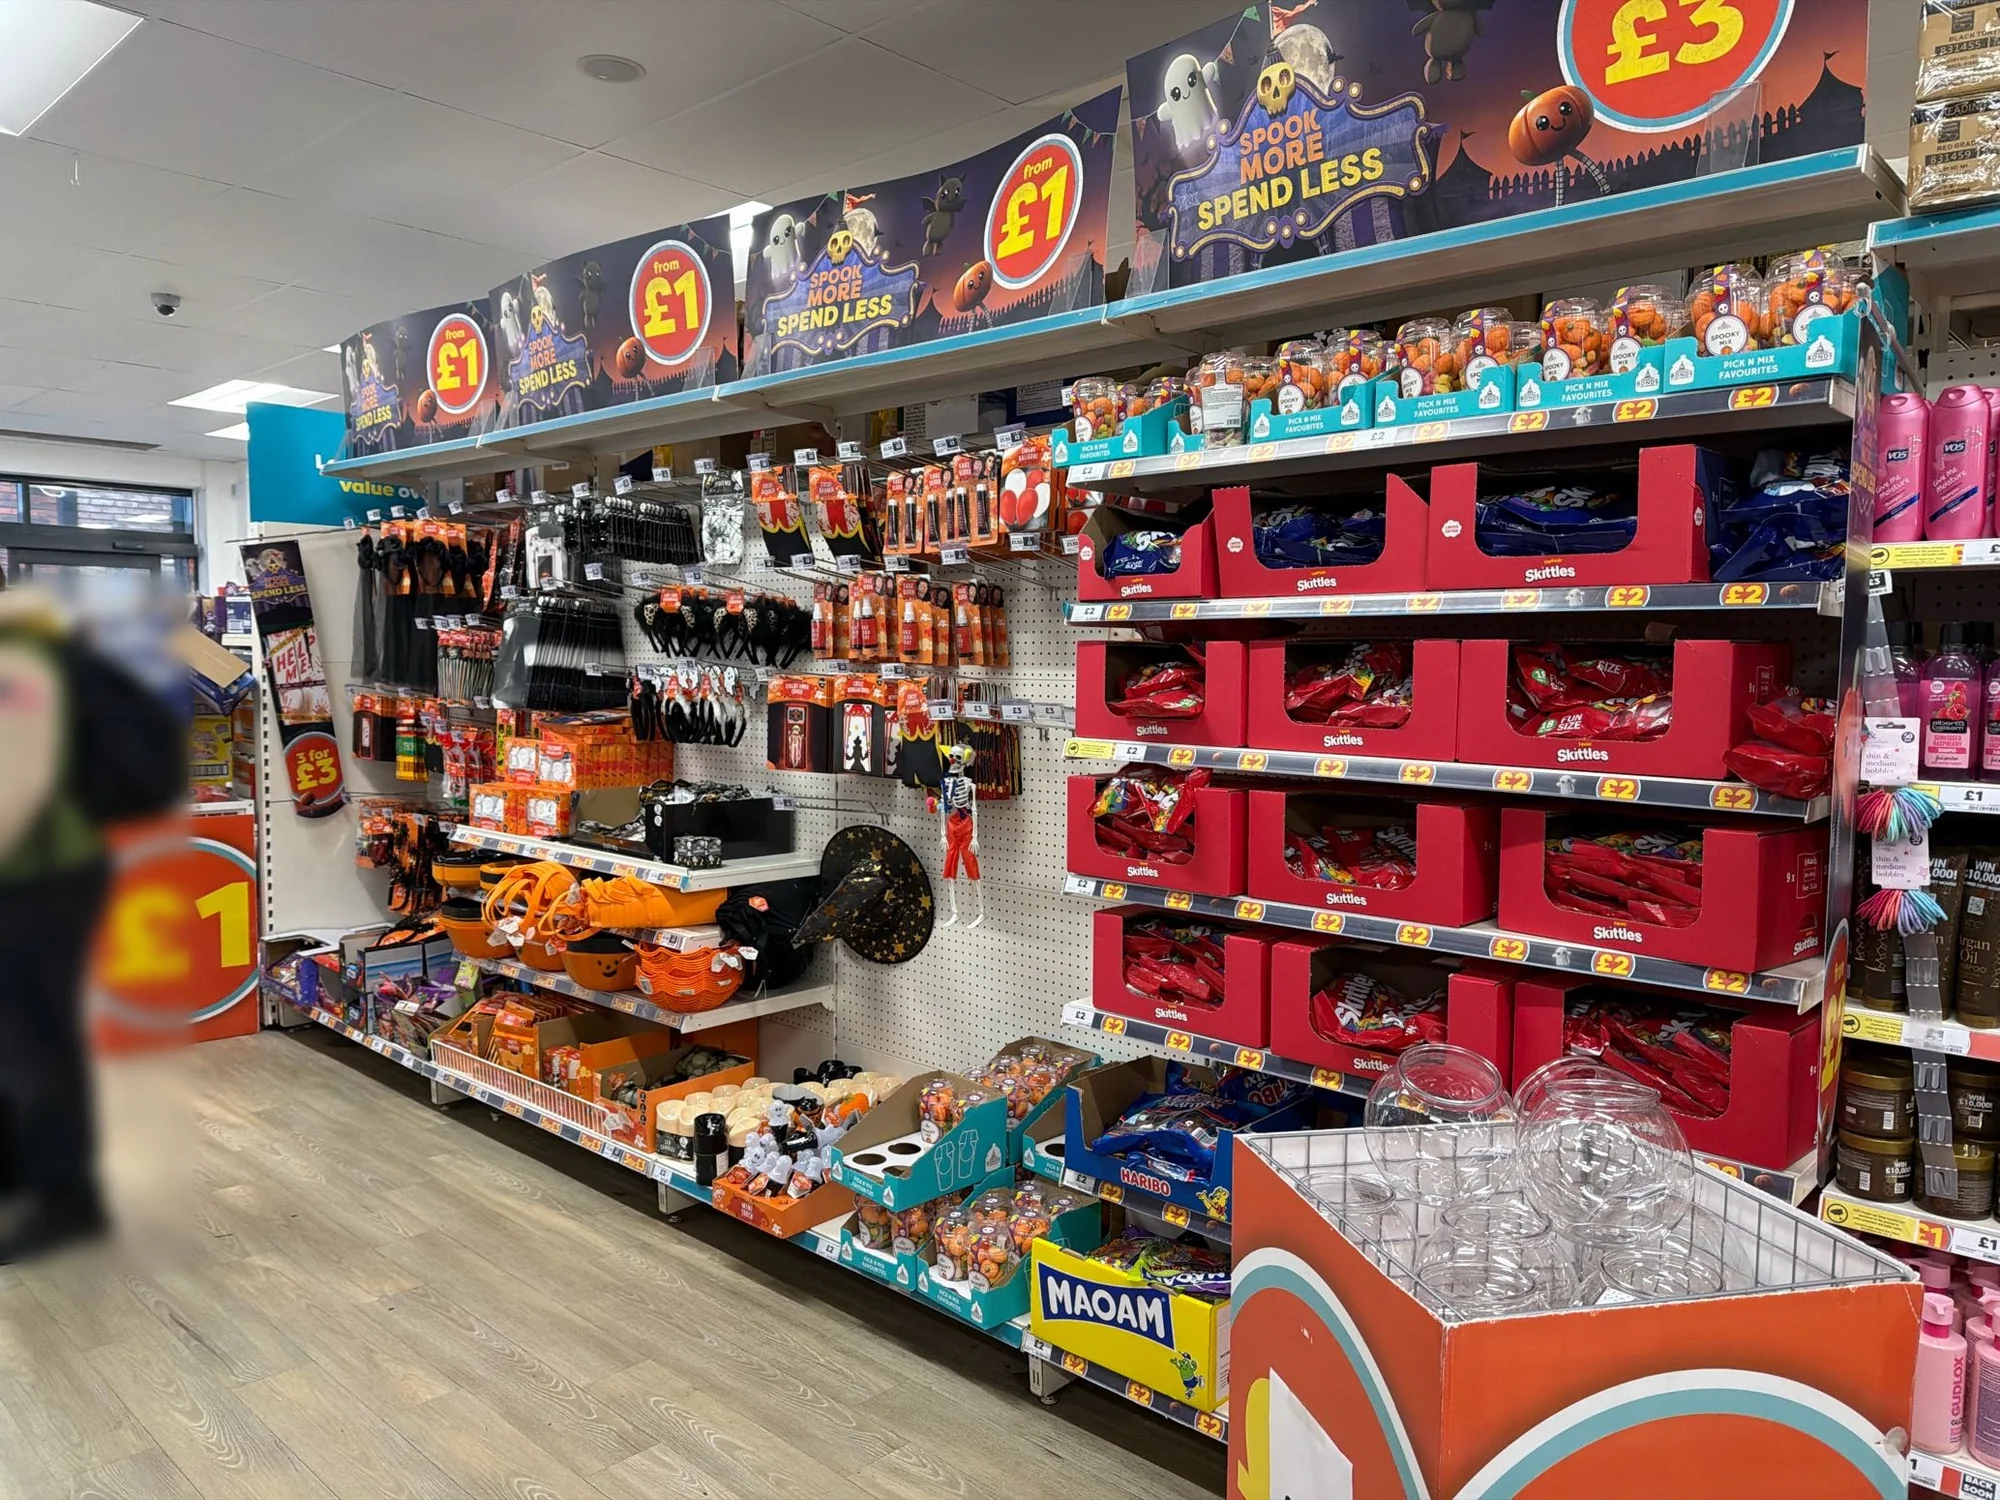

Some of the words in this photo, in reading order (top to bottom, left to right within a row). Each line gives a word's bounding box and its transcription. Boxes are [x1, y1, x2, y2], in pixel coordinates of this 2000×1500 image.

[1604, 0, 1746, 85] £3
[1940, 40, 1982, 56] 831455
[1240, 108, 1322, 156] SPOOK
[1937, 144, 1953, 152] RED
[1240, 134, 1325, 185] MORE
[1930, 150, 1972, 164] 831459
[1023, 155, 1053, 181] from
[1197, 176, 1293, 231] SPEND
[1301, 147, 1385, 199] LESS
[996, 164, 1069, 260] £1
[653, 259, 680, 274] from
[810, 264, 862, 289] SPOOK
[807, 279, 861, 307] MORE
[643, 268, 701, 337] £1
[777, 301, 840, 337] SPEND
[842, 294, 892, 324] LESS
[445, 329, 465, 339] from
[1710, 331, 1740, 342] SPOOKY
[1719, 338, 1732, 346] MIX
[528, 336, 554, 356] SPOOK
[529, 349, 557, 371] MORE
[1613, 352, 1636, 360] SPOOKY
[1723, 359, 1744, 369] PICK
[1748, 358, 1754, 366] N
[1756, 355, 1775, 365] MIX
[1807, 353, 1833, 361] BONDS
[436, 338, 478, 391] £1
[1719, 365, 1779, 379] FAVOURITES
[519, 368, 549, 395] SPEND
[551, 359, 577, 385] LESS
[1565, 383, 1584, 393] PICK
[1586, 382, 1592, 390] N
[1593, 380, 1609, 389] MIX
[1417, 400, 1435, 409] PICK
[1436, 399, 1442, 407] N
[1442, 397, 1456, 406] MIX
[1561, 389, 1612, 402] FAVOURITES
[1735, 387, 1772, 408] £2
[356, 411, 373, 431] SPEND
[374, 405, 391, 425] LESS
[1414, 406, 1459, 418] FAVOURITES
[1619, 400, 1652, 421] £2
[1516, 414, 1542, 429] £2
[1370, 432, 1385, 441] £2
[1111, 463, 1132, 476] £2
[339, 480, 394, 497] value
[1524, 566, 1576, 582] Skittles
[1120, 584, 1152, 598] Skittles
[1297, 576, 1336, 591] Skittles
[251, 587, 283, 600] SPEND
[284, 584, 306, 593] LESS
[1611, 588, 1645, 606] £2
[1725, 585, 1762, 604] £2
[1084, 607, 1095, 616] £2
[1107, 606, 1129, 619] £2
[1173, 604, 1196, 618] £2
[275, 634, 316, 673] HELP
[1597, 660, 1622, 675] SIZE
[1012, 707, 1023, 715] £3
[1561, 713, 1583, 723] FUN
[1136, 724, 1168, 736] Skittles
[1557, 720, 1584, 731] SIZE
[1323, 734, 1363, 748] Skittles
[296, 752, 307, 766] 3
[310, 748, 330, 761] for
[1126, 746, 1138, 756] £2
[1170, 750, 1193, 764] £2
[1556, 747, 1609, 763] Skittles
[1866, 752, 1882, 760] thin
[1240, 755, 1265, 770] £2
[297, 757, 337, 791] £3
[1401, 766, 1433, 783] £2
[1497, 772, 1529, 791] £2
[1601, 780, 1634, 800] £2
[1963, 791, 1983, 802] £1
[1715, 789, 1751, 808] £2
[1127, 866, 1158, 878] Skittles
[1875, 863, 1907, 871] medium
[1875, 870, 1905, 878] bobbles
[1975, 860, 1996, 873] WIN
[1076, 879, 1088, 888] £2
[1104, 884, 1124, 899] £2
[1168, 895, 1189, 909] £2
[1326, 893, 1367, 907] Skittles
[1238, 902, 1261, 919] £2
[1400, 926, 1428, 945] £2
[1593, 926, 1643, 943] Skittles
[1596, 953, 1629, 975] £2
[1960, 949, 1978, 964] Oil
[1709, 972, 1743, 992] £2
[1075, 1010, 1086, 1020] £2
[1155, 1008, 1188, 1022] Skittles
[1104, 1018, 1124, 1034] £2
[1238, 1050, 1261, 1068] £2
[1075, 1174, 1087, 1184] £2
[1120, 1167, 1170, 1196] HARIBO
[1165, 1206, 1186, 1226] £2
[1978, 1236, 1998, 1251] £1
[1047, 1275, 1166, 1339] MAOAM
[1065, 1354, 1087, 1374] £2
[1129, 1383, 1151, 1404] £2
[1952, 1356, 1964, 1417] GUDLOX
[1199, 1413, 1221, 1436] £2
[1964, 1475, 1994, 1491] BACK
[1962, 1483, 1993, 1500] SOON
